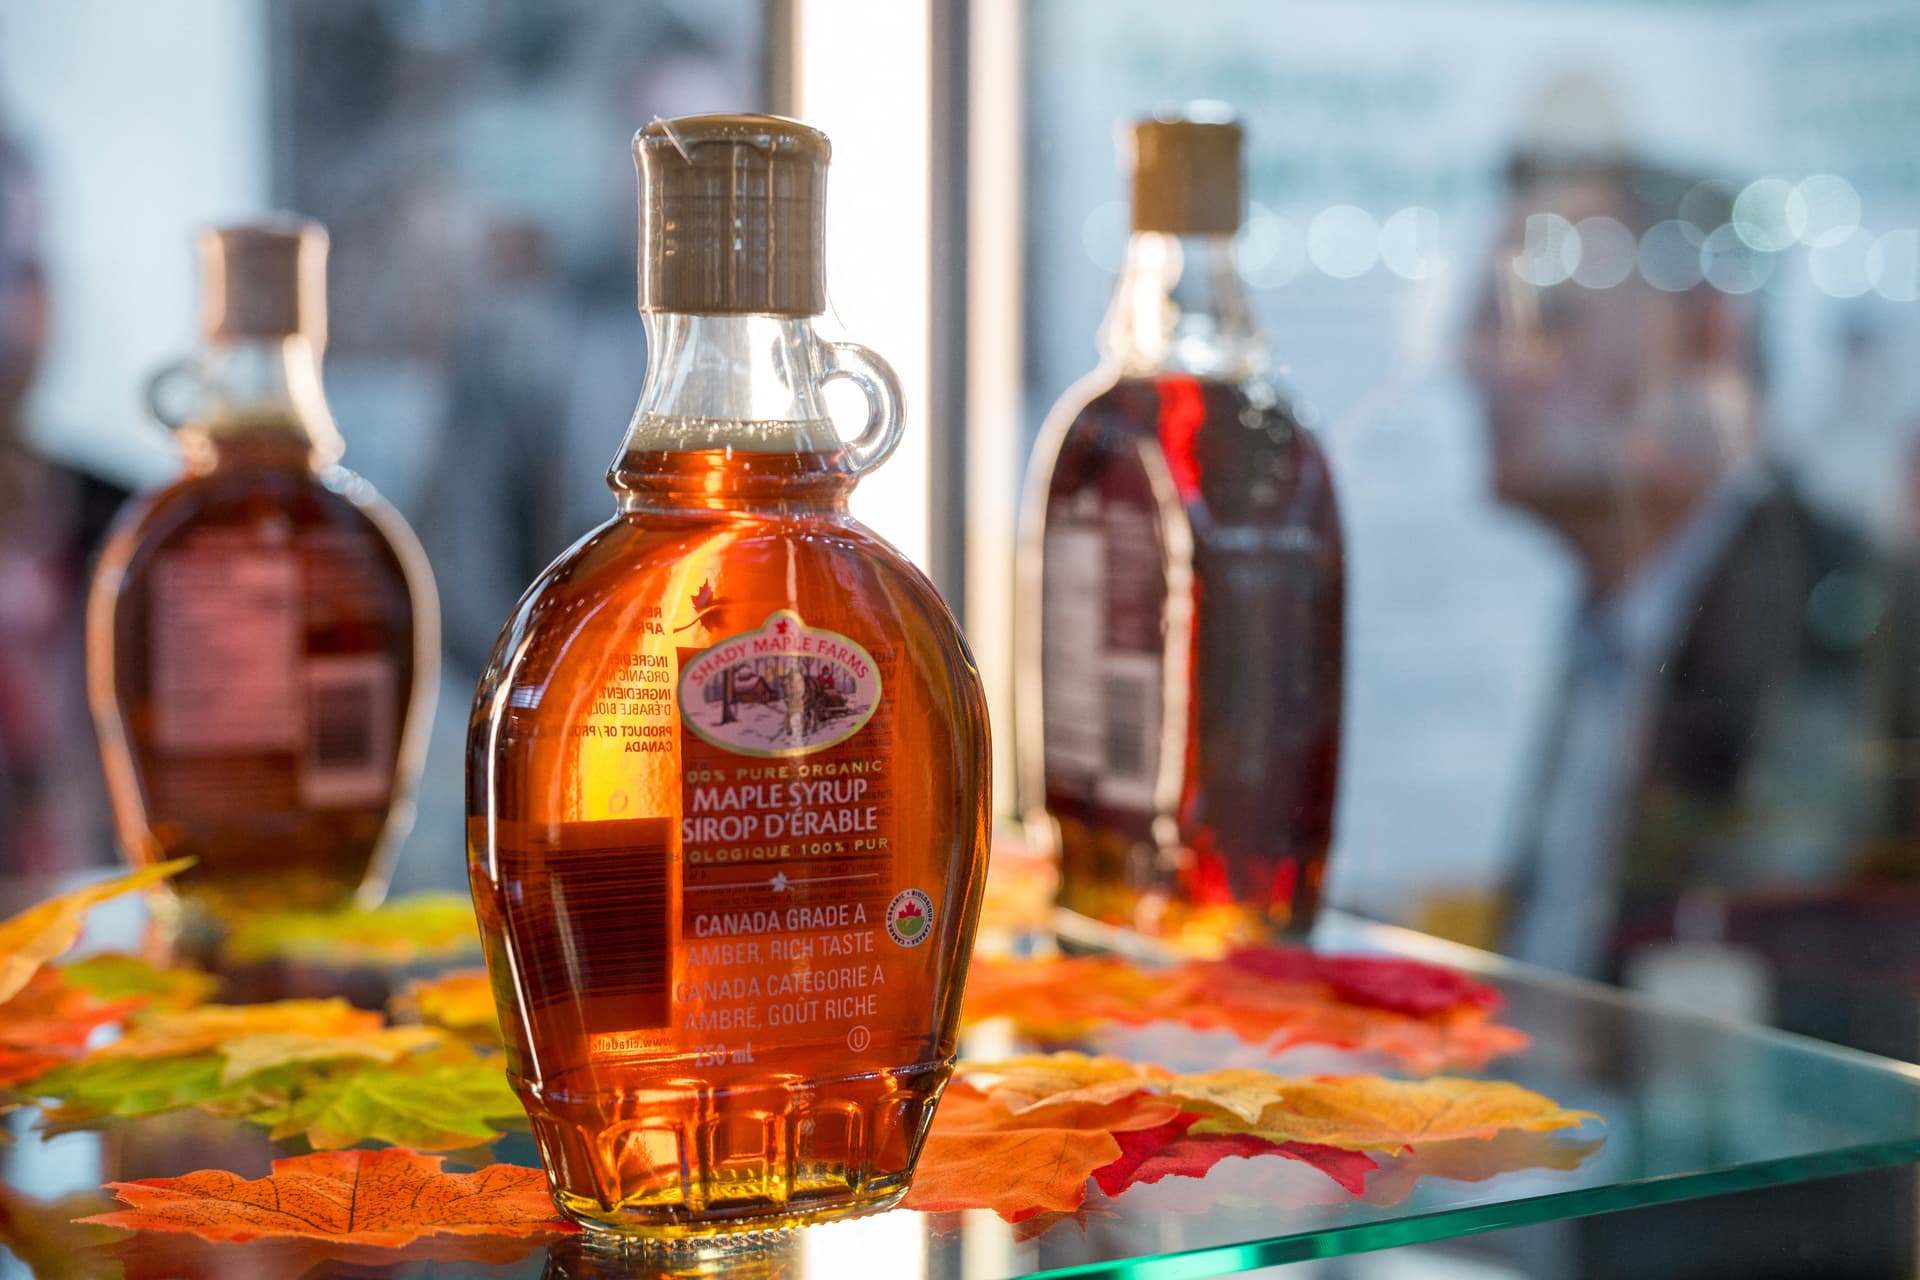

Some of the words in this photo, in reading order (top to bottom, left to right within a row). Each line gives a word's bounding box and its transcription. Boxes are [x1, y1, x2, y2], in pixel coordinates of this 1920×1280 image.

[691, 641, 747, 687] SHADY
[754, 635, 811, 652] MAPLE
[817, 639, 869, 680] FARMS
[686, 769, 726, 785] 00%
[736, 766, 789, 781] PURE
[799, 760, 882, 777] ORGANIC
[692, 784, 783, 813] MAPLE
[788, 778, 868, 807] SYRUP
[682, 814, 758, 843] SIROP
[764, 806, 878, 839] D'ÉRABLE
[801, 841, 845, 855] 100%
[854, 838, 889, 850] PUR
[695, 911, 781, 938] CANADA
[786, 905, 849, 929] GRADE
[854, 902, 868, 924] A
[687, 941, 765, 967] AMBER,
[770, 935, 815, 961] RICH
[820, 931, 875, 954] TASTE
[676, 976, 761, 1004] CANADA
[767, 965, 868, 996] CATÉGORIE
[872, 965, 886, 985] A
[684, 1001, 763, 1032] AMBRÉ,
[768, 998, 819, 1026] GOÛT
[825, 994, 878, 1020] RICHE
[731, 1041, 755, 1064] mL
